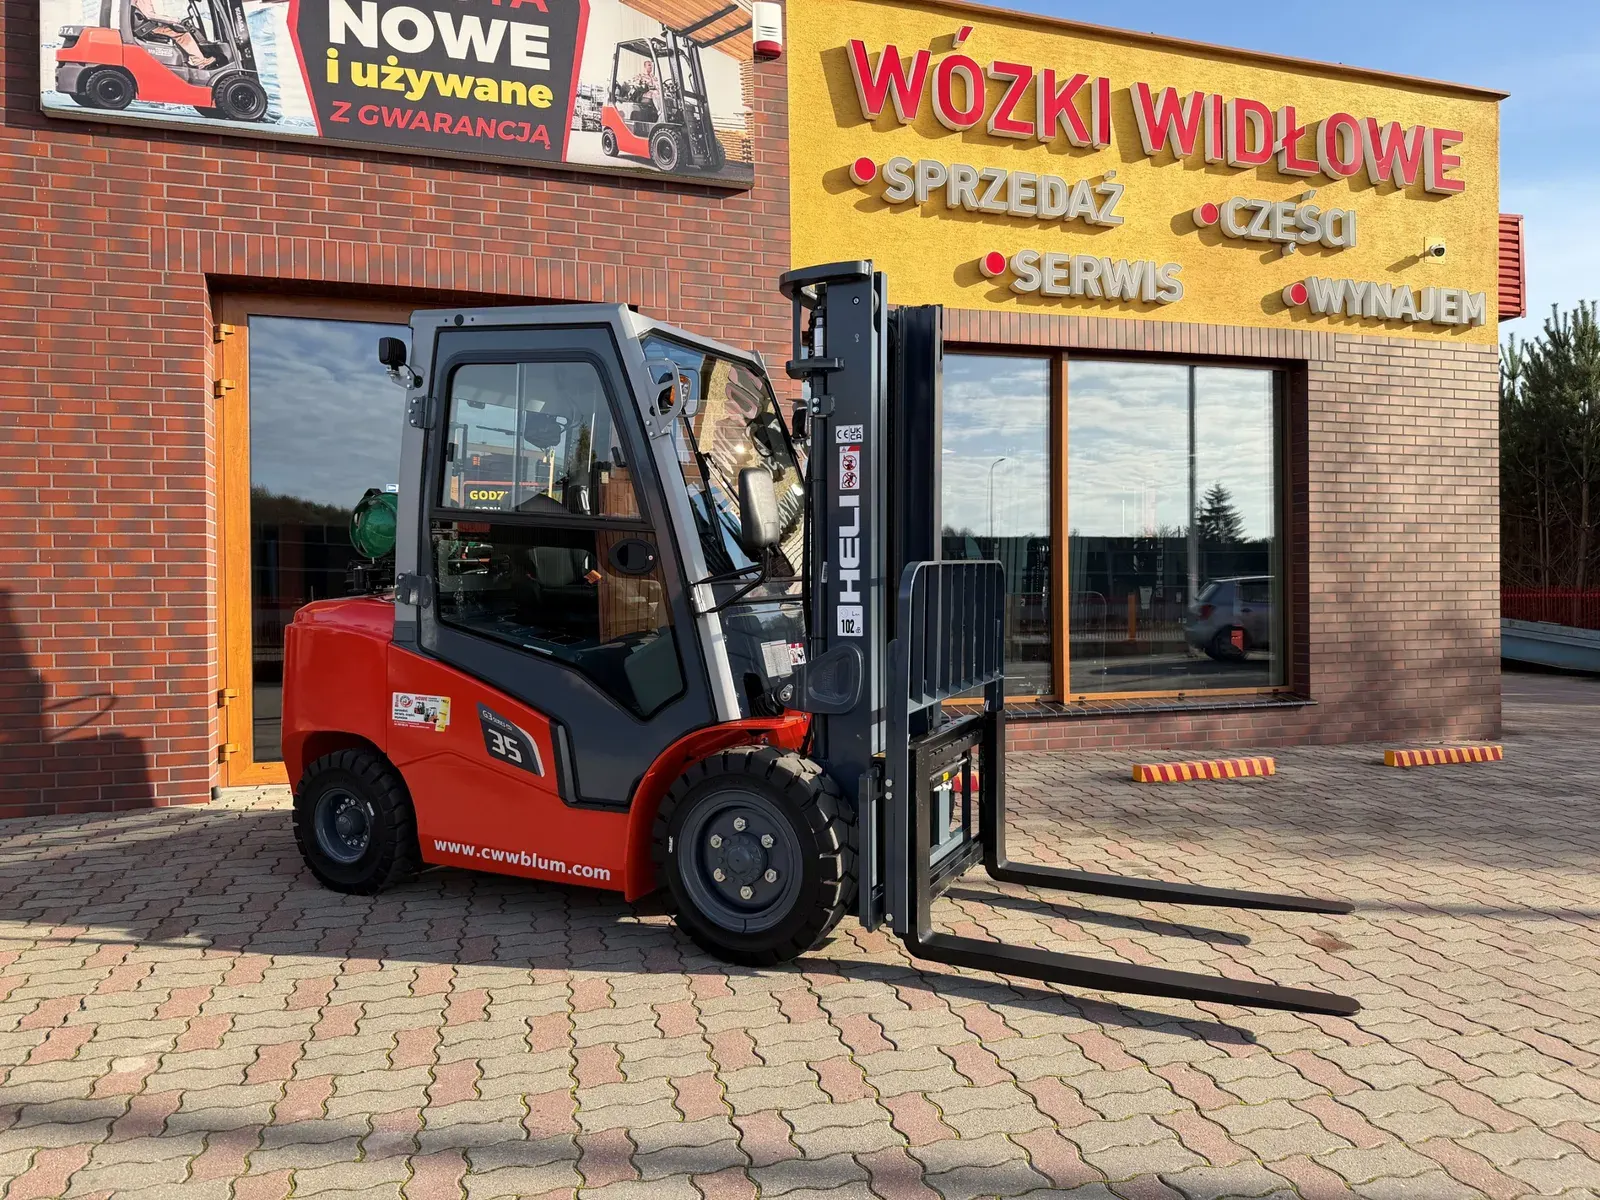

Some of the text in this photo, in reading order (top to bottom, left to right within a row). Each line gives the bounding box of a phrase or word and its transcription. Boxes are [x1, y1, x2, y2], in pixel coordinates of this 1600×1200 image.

[328, 0, 551, 71] NOWE
[326, 47, 554, 109] i używane
[329, 100, 552, 151] Z GWARANCJĄ
[846, 25, 1466, 195] WÓZKI WIDŁOWE
[881, 156, 1125, 228] SPRZEDAŻ
[1219, 189, 1357, 255] CZĘŚCI
[1009, 249, 1184, 304] SERWIS
[1304, 275, 1487, 326] WYNAJEM
[469, 490, 509, 501] GODZ
[838, 495, 861, 603] HELI
[841, 618, 855, 634] 102
[488, 728, 523, 763] 35
[433, 838, 612, 882] www.cwwblum.com
